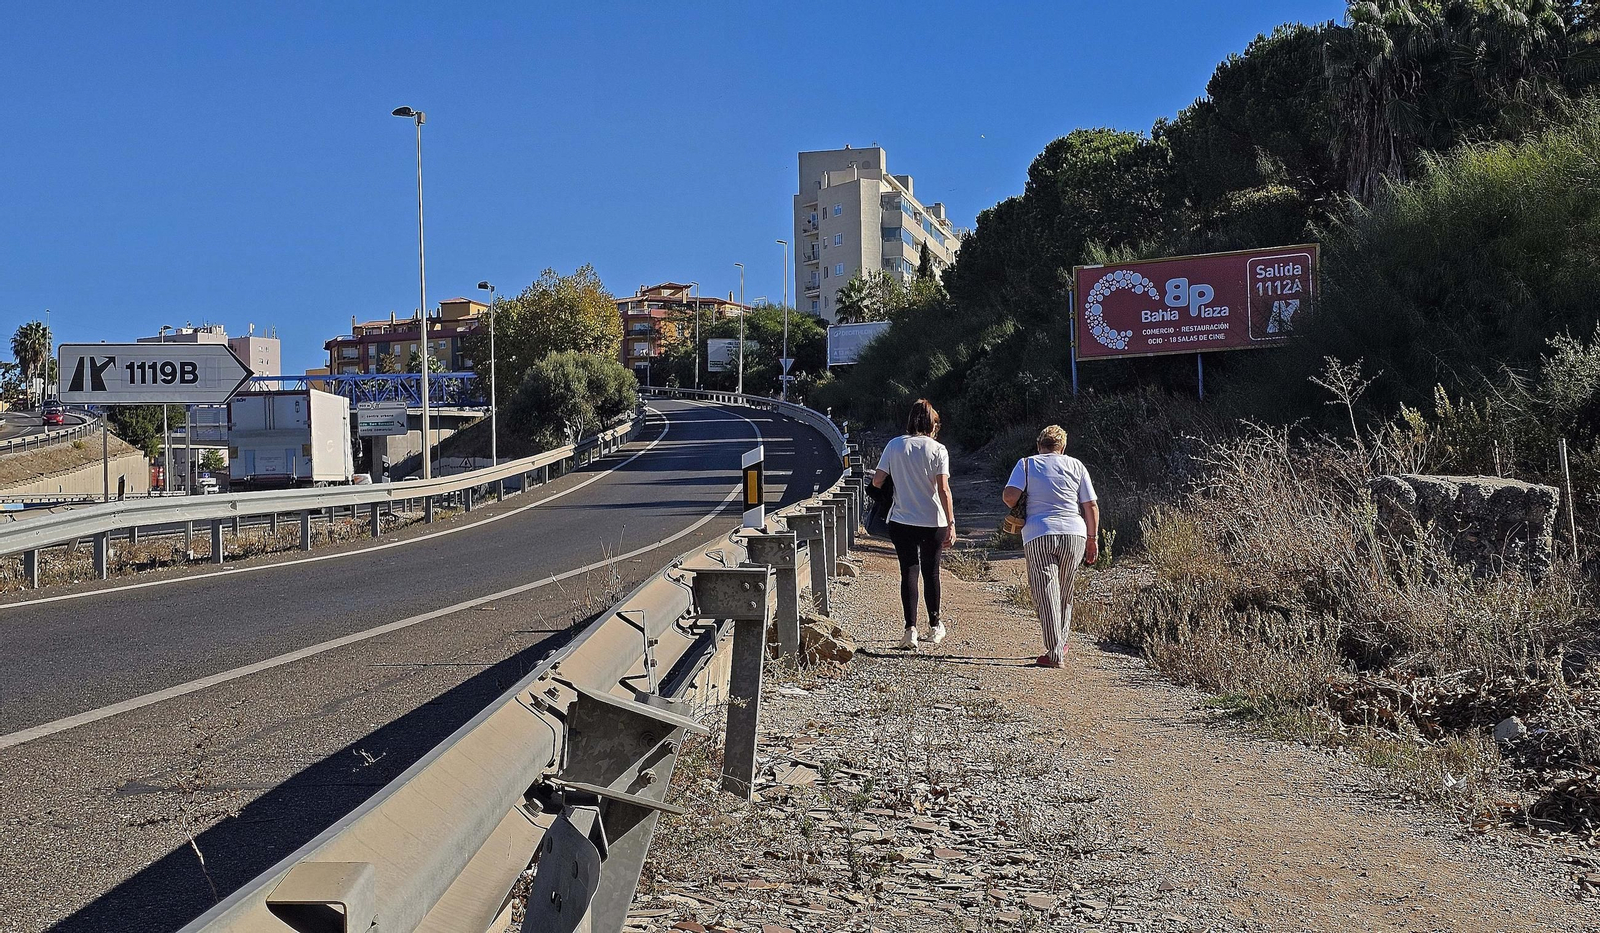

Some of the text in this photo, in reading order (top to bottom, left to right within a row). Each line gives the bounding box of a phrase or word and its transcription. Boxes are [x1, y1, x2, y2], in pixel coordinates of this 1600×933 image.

[1256, 263, 1302, 279] Salida
[1256, 279, 1302, 296] 1112A
[1141, 308, 1179, 323] Bahía
[1142, 322, 1229, 336] COMERCIO RESTAURACIÓN
[1177, 335, 1198, 343] SALAS
[125, 360, 199, 385] 1119B
